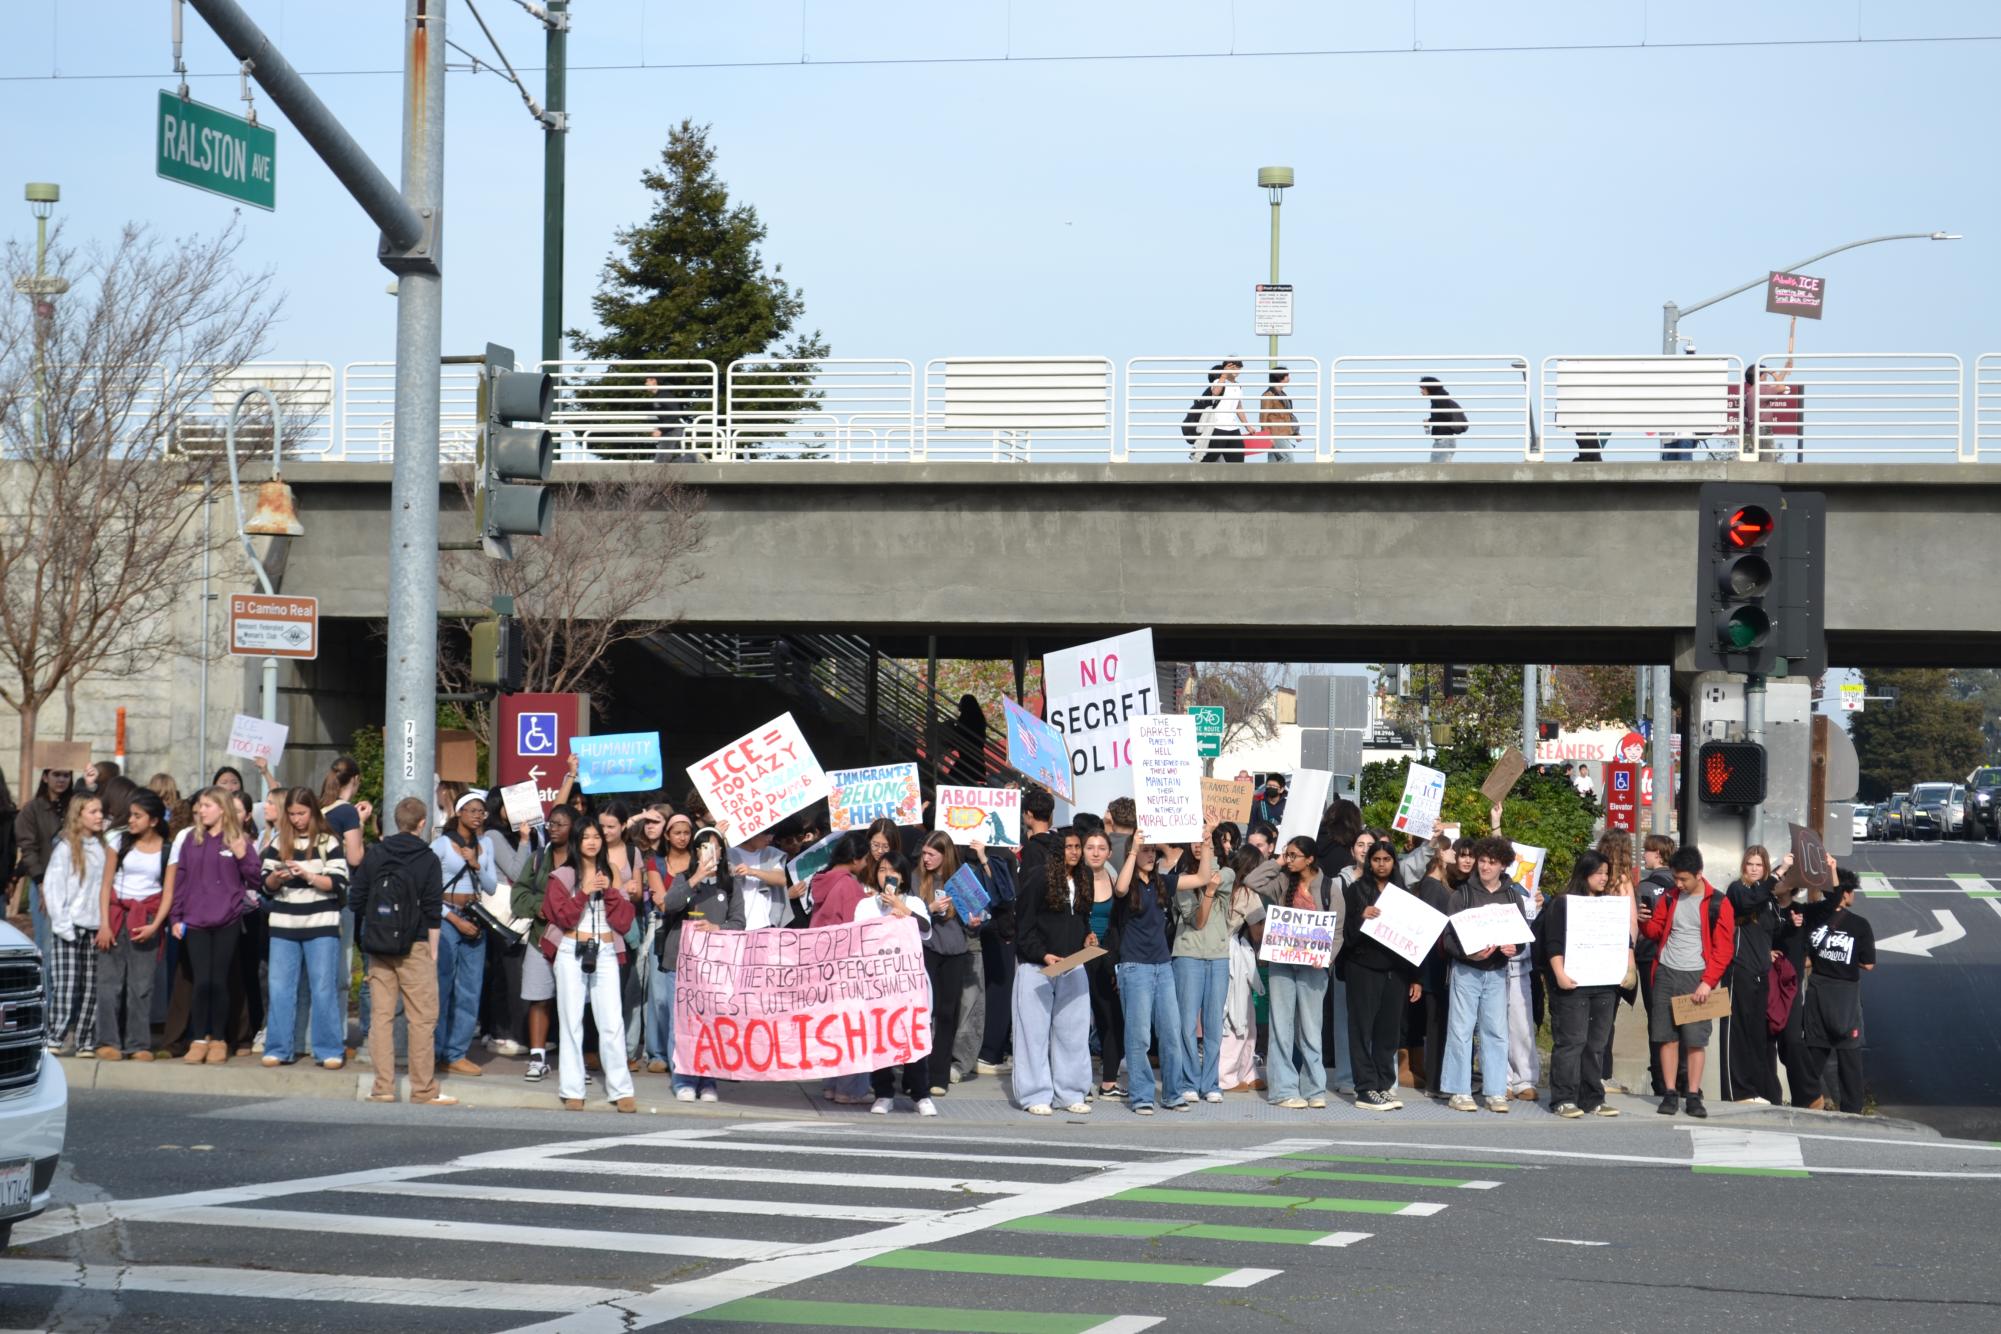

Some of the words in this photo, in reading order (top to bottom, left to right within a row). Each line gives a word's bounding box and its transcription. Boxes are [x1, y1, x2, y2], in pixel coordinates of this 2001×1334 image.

[163, 114, 248, 183] RALSTON
[251, 153, 271, 183] AVE
[1799, 276, 1819, 290] ICE
[234, 601, 245, 613] El
[247, 602, 287, 615] Camino
[290, 604, 313, 616] Real
[1080, 654, 1119, 687] NO
[1050, 687, 1151, 734] SECRET
[1152, 717, 1169, 726] THE
[1140, 726, 1183, 738] DARKEST
[232, 739, 253, 753] TOO
[406, 722, 414, 777] 7932
[581, 740, 651, 757] HUMANITY
[1154, 747, 1172, 756] HELL
[1537, 743, 1605, 760] LEANERS
[591, 758, 635, 774] FIRST
[700, 737, 763, 787] ICE
[710, 776, 745, 801] TOO
[745, 741, 797, 783] LAZY
[834, 764, 912, 787] IMMIGRANTS
[1145, 776, 1181, 787] MAINTAIN
[721, 792, 748, 813] FOR
[750, 787, 761, 799] A
[839, 781, 908, 806] BELONG
[941, 789, 1017, 807] ABOLISH
[1146, 796, 1190, 805] NEUTRALITY
[730, 801, 764, 821] TOO
[951, 809, 978, 825] ICE
[738, 815, 765, 836] FOR
[769, 808, 781, 822] A
[1138, 814, 1168, 827] MORAL
[1169, 814, 1198, 827] CRISIS
[1614, 821, 1629, 829] Train
[1801, 839, 1827, 875] ICE
[1315, 914, 1336, 927] LET
[681, 922, 725, 961] WE
[731, 930, 769, 966] THE
[1265, 934, 1299, 947] BLIND
[1303, 940, 1331, 952] YOUR
[1373, 922, 1420, 956] KILLERS
[1271, 948, 1326, 963] EMPATHY
[677, 957, 735, 986] RETAIN
[738, 967, 763, 988] THE
[765, 964, 815, 988] RIGHT
[819, 961, 834, 981] TO
[837, 952, 923, 981] PEACEFULLY
[676, 987, 756, 1017] PROTEST
[760, 982, 838, 1015] WITHOUT
[840, 973, 926, 1002] PUNISHMENT
